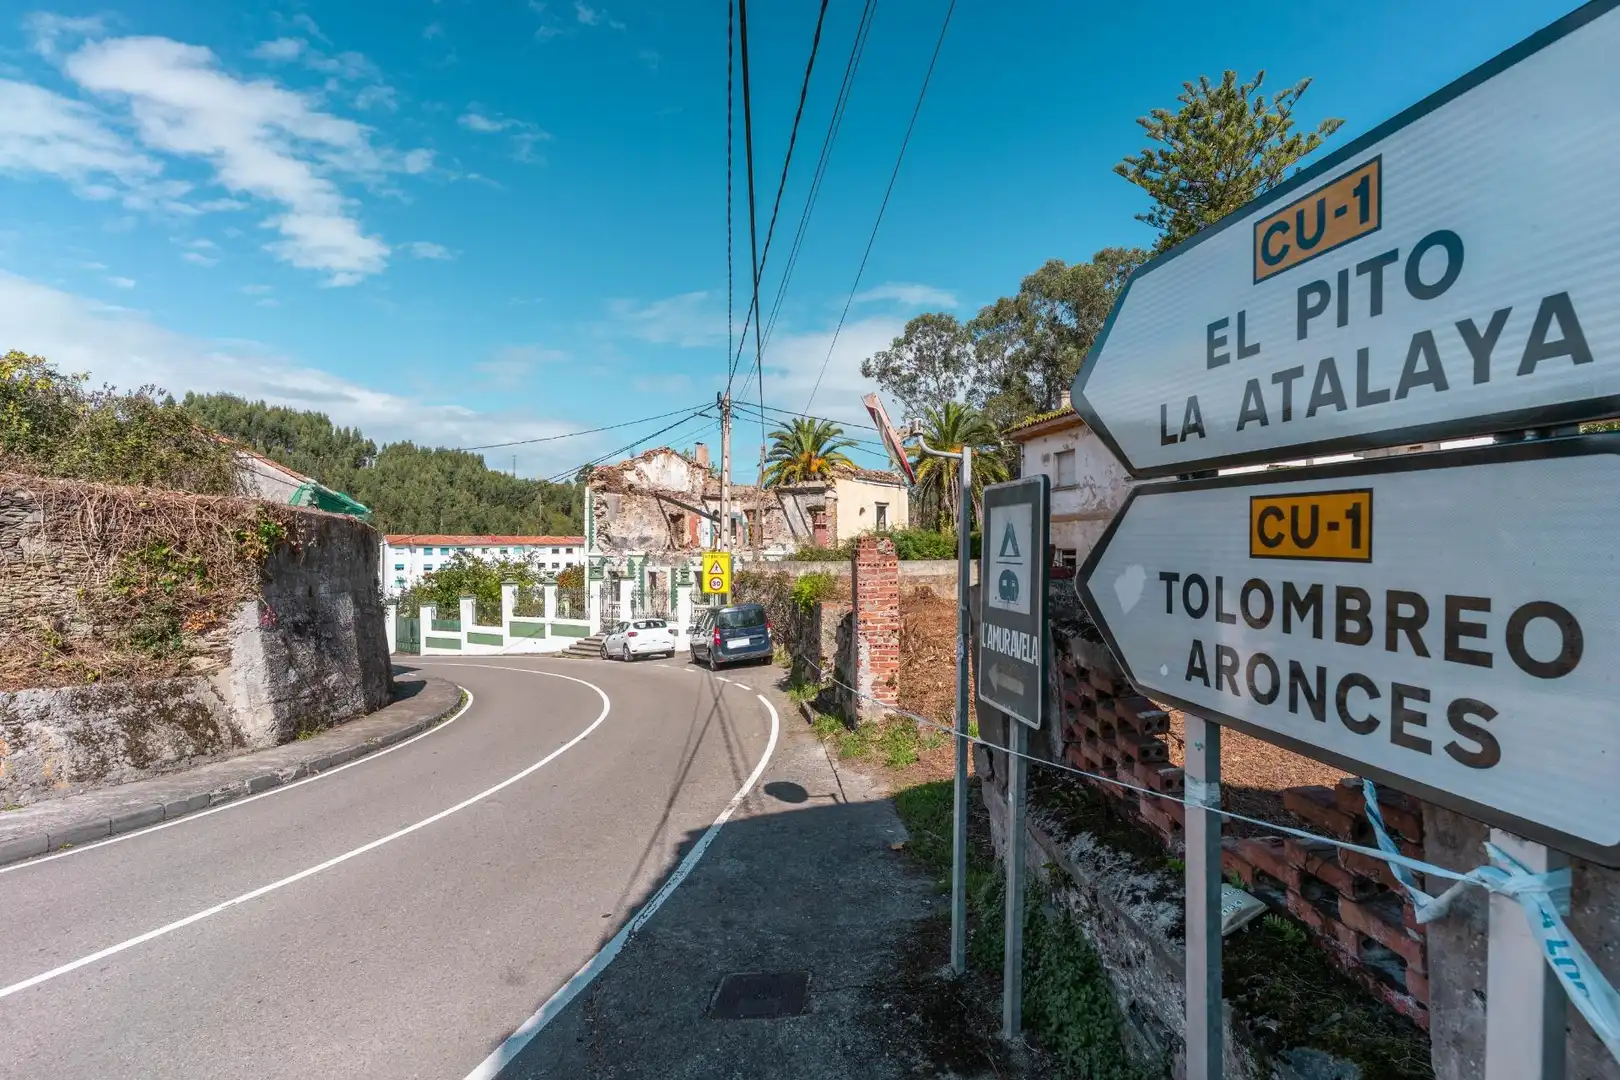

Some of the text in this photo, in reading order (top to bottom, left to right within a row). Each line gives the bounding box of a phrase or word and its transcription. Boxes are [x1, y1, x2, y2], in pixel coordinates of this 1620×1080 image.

[1260, 174, 1371, 267] CU-1
[1206, 229, 1465, 370] EL PITO
[1160, 291, 1594, 446] LA ATALAYA
[1257, 502, 1362, 550] CU-1
[982, 622, 1039, 666] L'AMURAVELA
[1159, 571, 1584, 679] TOLOMBREO
[1185, 639, 1501, 769] ARONCES
